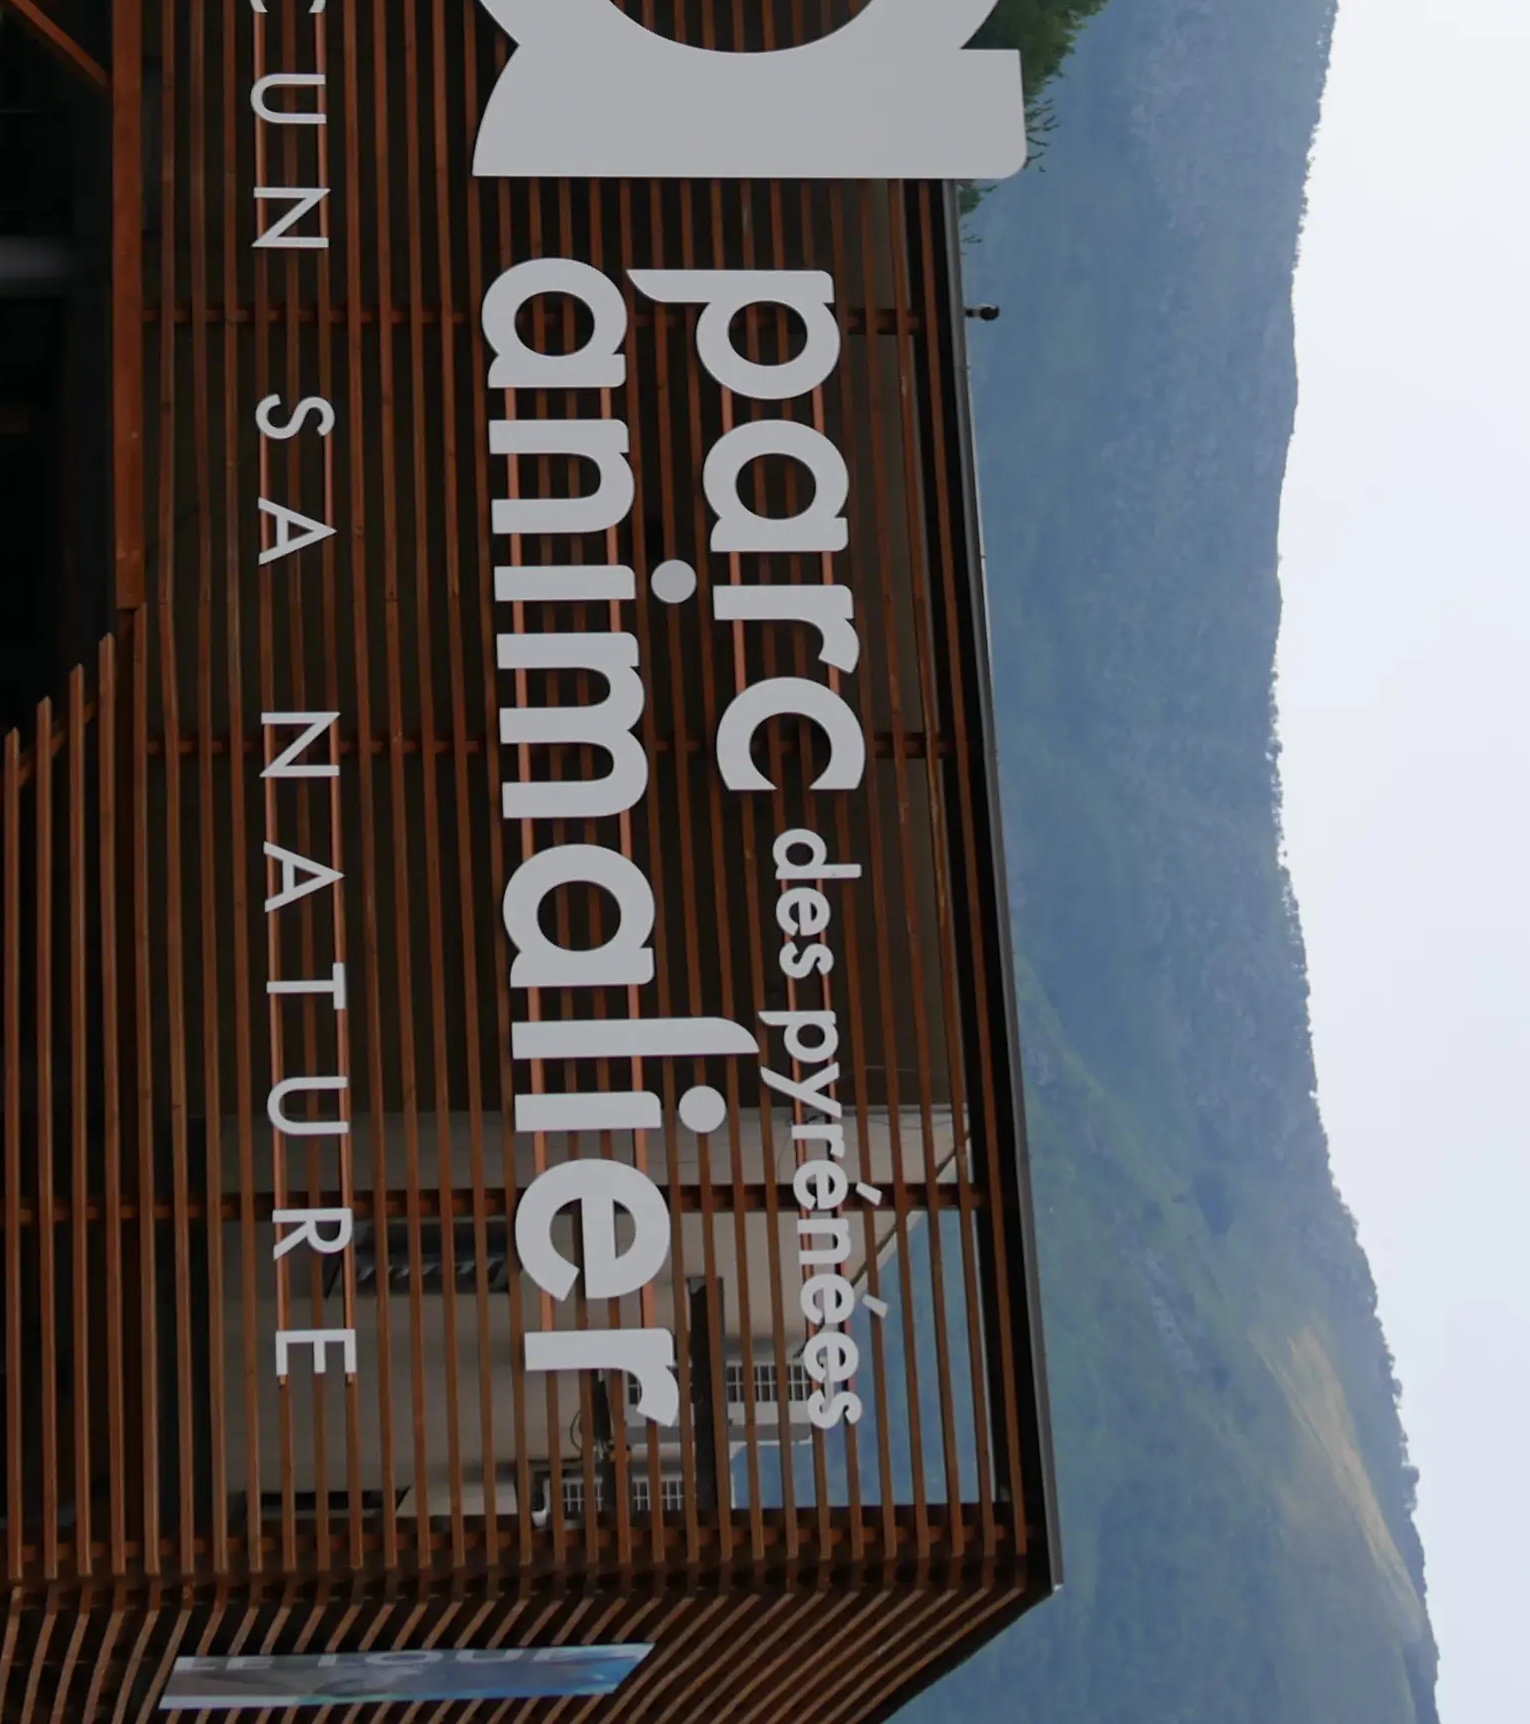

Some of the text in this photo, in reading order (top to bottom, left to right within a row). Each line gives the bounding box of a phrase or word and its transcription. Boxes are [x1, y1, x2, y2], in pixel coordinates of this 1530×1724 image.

[255, 394, 337, 565] SA
[626, 269, 865, 791] parc
[260, 711, 357, 1376] NATURE
[481, 257, 760, 1428] animalier
[758, 828, 888, 1430] des pyrénées
